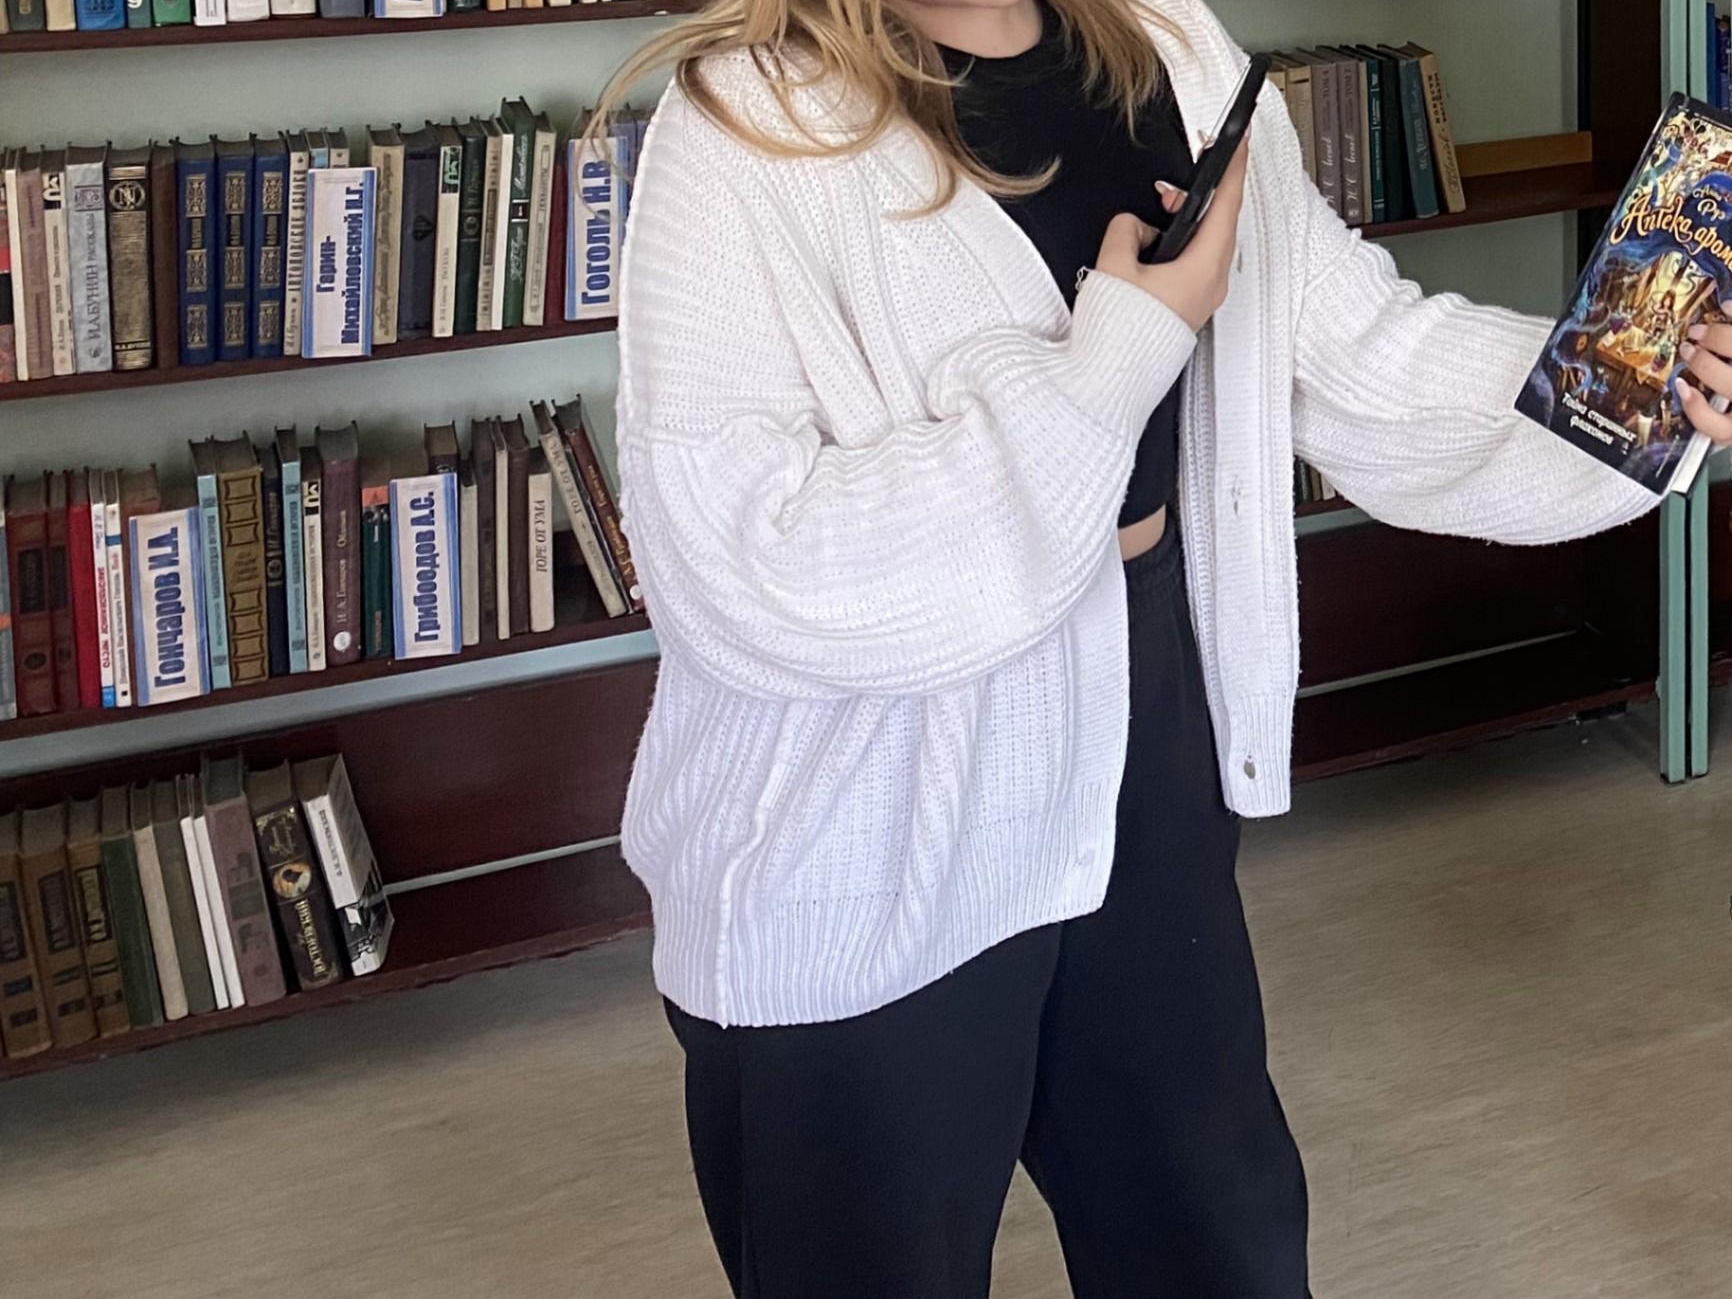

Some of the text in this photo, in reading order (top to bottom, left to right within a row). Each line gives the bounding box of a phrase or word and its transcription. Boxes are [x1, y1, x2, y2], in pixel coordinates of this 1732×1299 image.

[1609, 193, 1693, 245] Аптека
[316, 235, 336, 292] Гарин-
[341, 213, 363, 344] Михайловский
[582, 210, 611, 305] Гоголь
[409, 491, 434, 527] А.С.
[533, 500, 548, 572] ГОРЕ ОТ УМА
[153, 572, 185, 687] Гончаров
